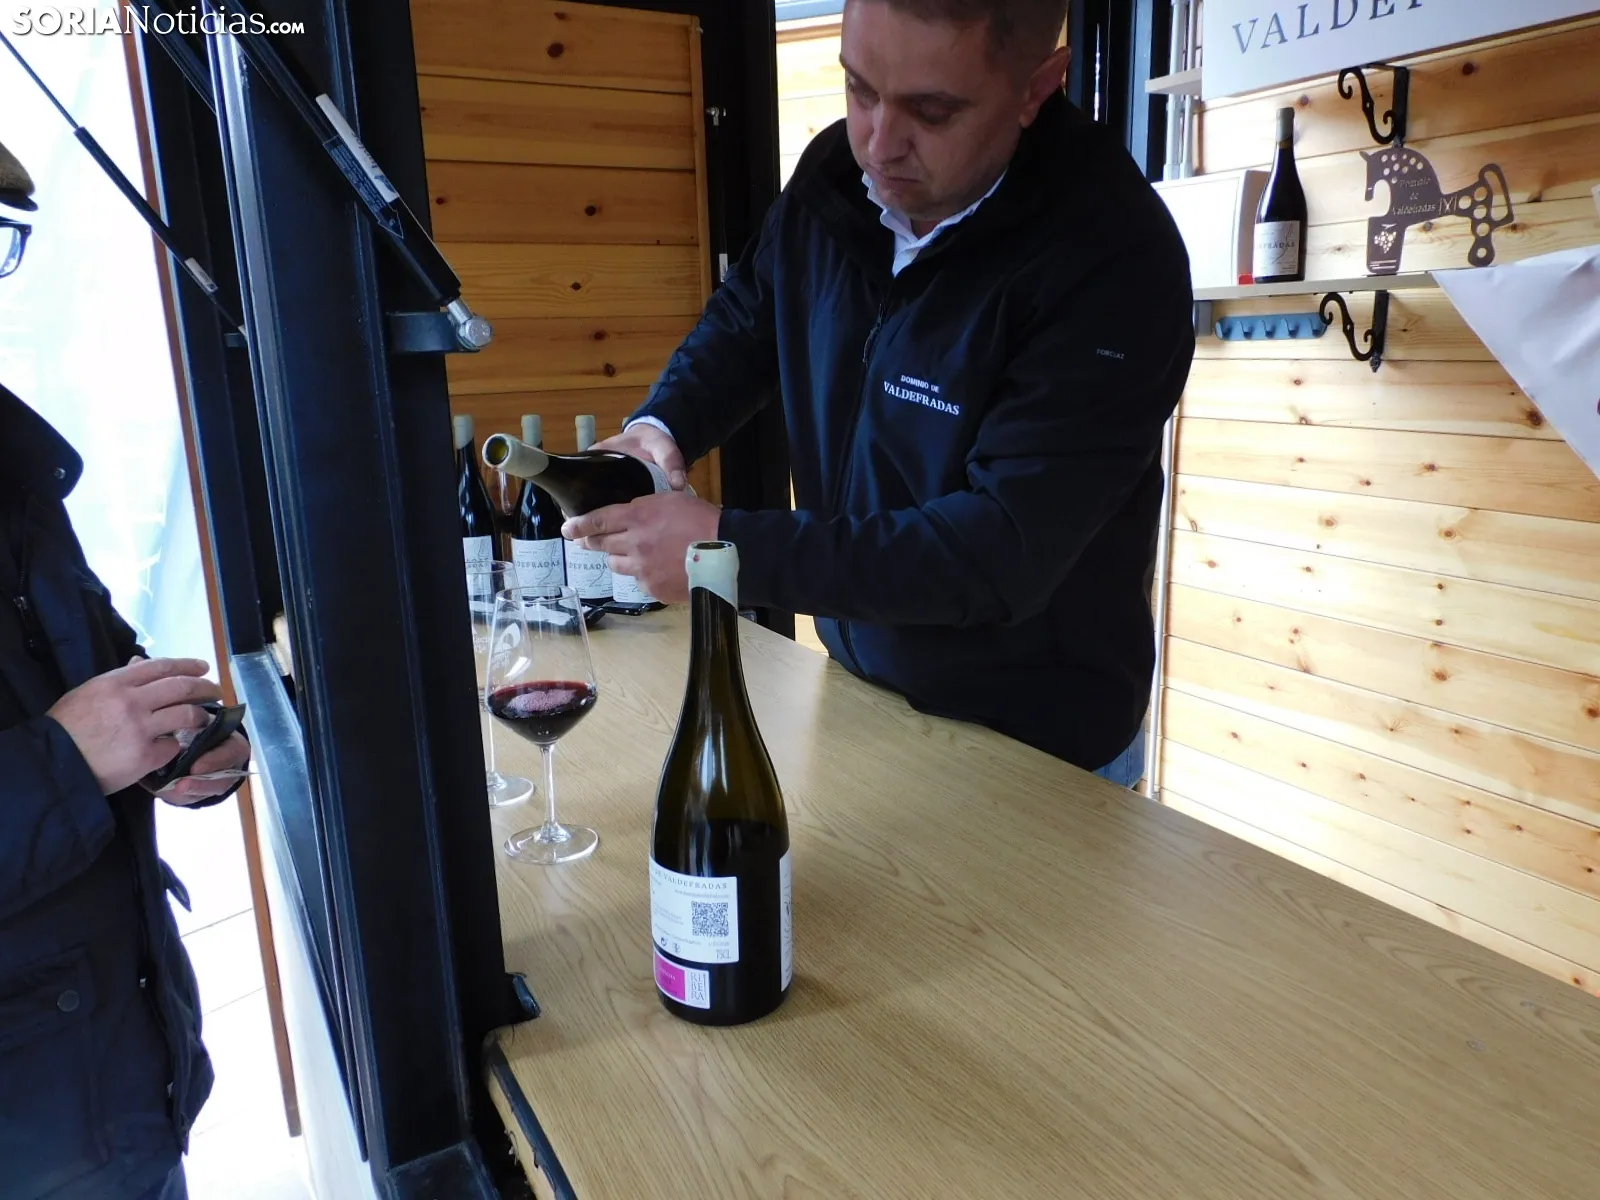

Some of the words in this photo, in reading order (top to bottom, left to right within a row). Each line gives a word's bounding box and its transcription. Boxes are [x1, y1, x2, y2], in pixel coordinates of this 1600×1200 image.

[1232, 0, 1423, 54] VALDE
[900, 374, 929, 389] DOMINIO
[930, 384, 940, 393] DE
[883, 380, 960, 416] VALDEFRADAS
[568, 562, 608, 571] DEFRADA
[663, 873, 728, 890] VALDEFRADAS
